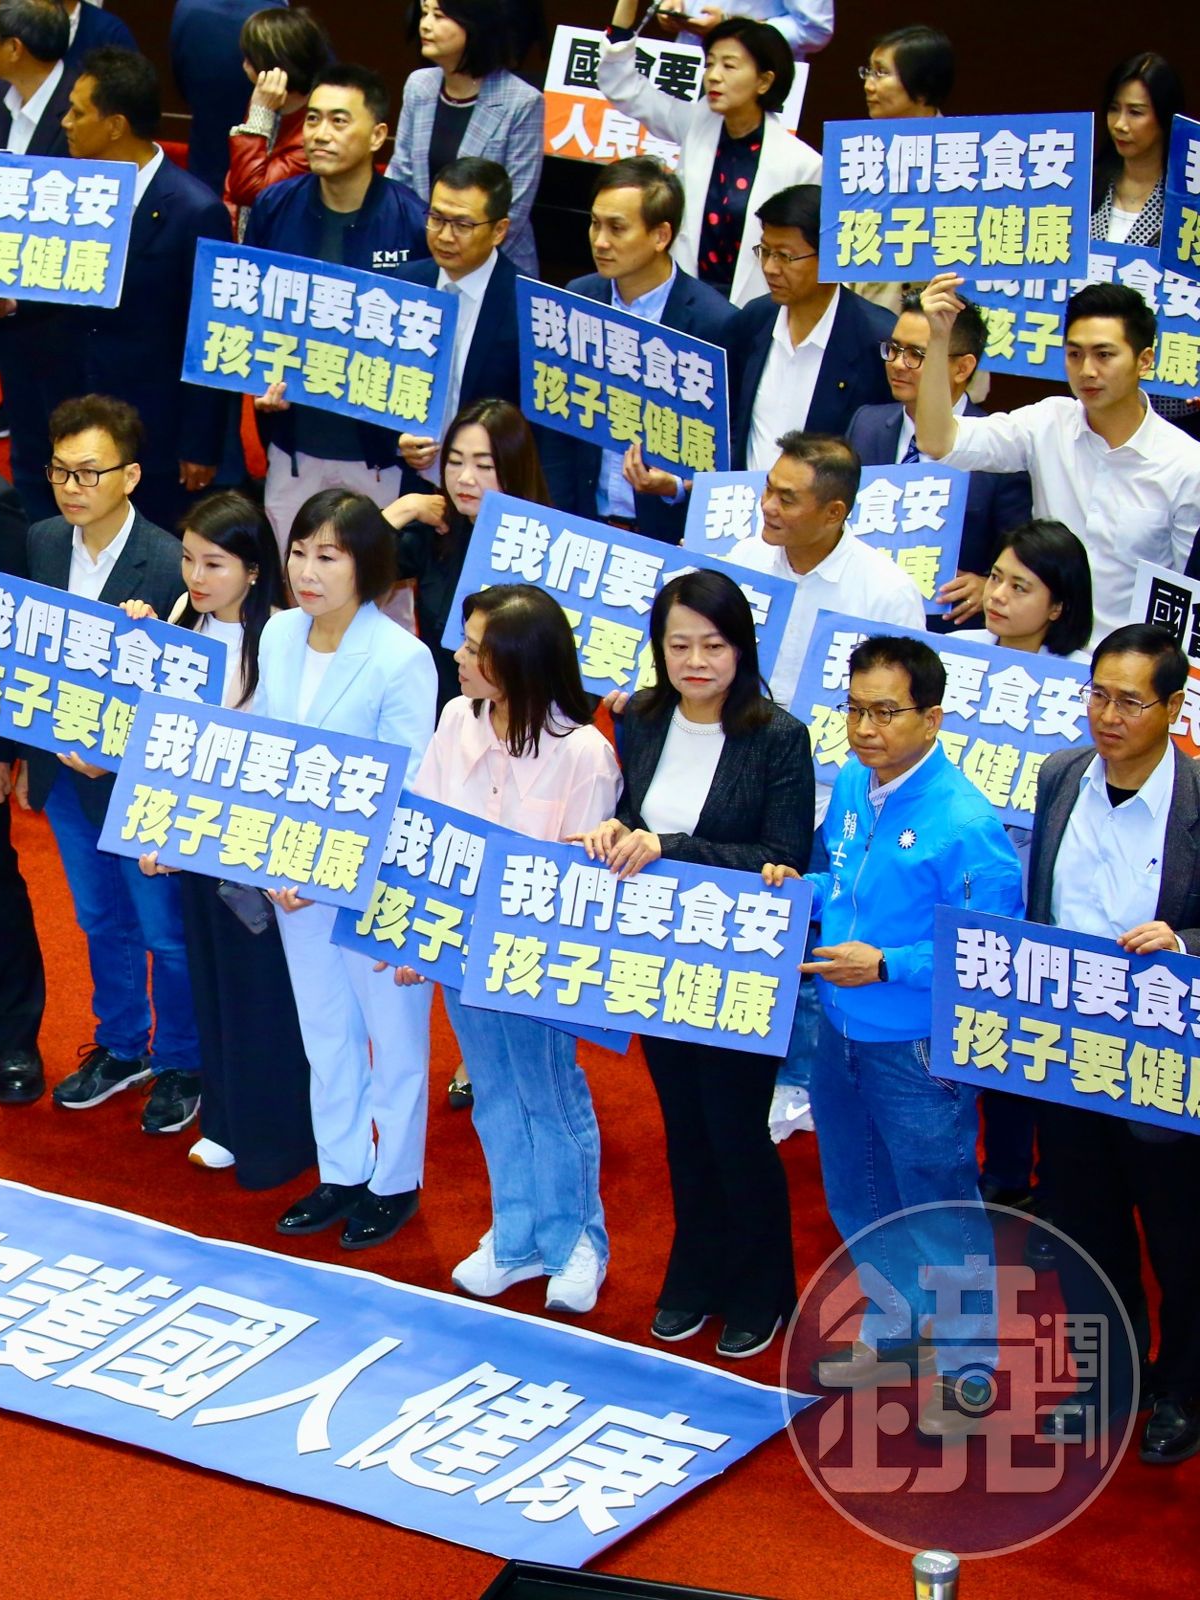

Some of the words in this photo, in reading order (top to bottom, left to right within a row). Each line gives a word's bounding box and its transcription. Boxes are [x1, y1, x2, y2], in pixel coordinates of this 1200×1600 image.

[839, 128, 1075, 195] 我們要食安
[373, 249, 410, 262] KMT
[836, 204, 1073, 267] 孩子要健康
[211, 256, 443, 358] 我們要食安
[530, 296, 715, 411] 我們要食安
[202, 321, 435, 424] 孩子要健康
[533, 360, 717, 473] 孩子要健康
[705, 476, 952, 541] 我食安
[144, 712, 390, 820] 我們要食安
[120, 783, 371, 894] 孩子要健康
[500, 854, 792, 959] 我們要食安
[484, 931, 780, 1038] 孩子要健康
[955, 927, 1200, 1039] 我們要食
[952, 1004, 1200, 1119] 孩子要健
